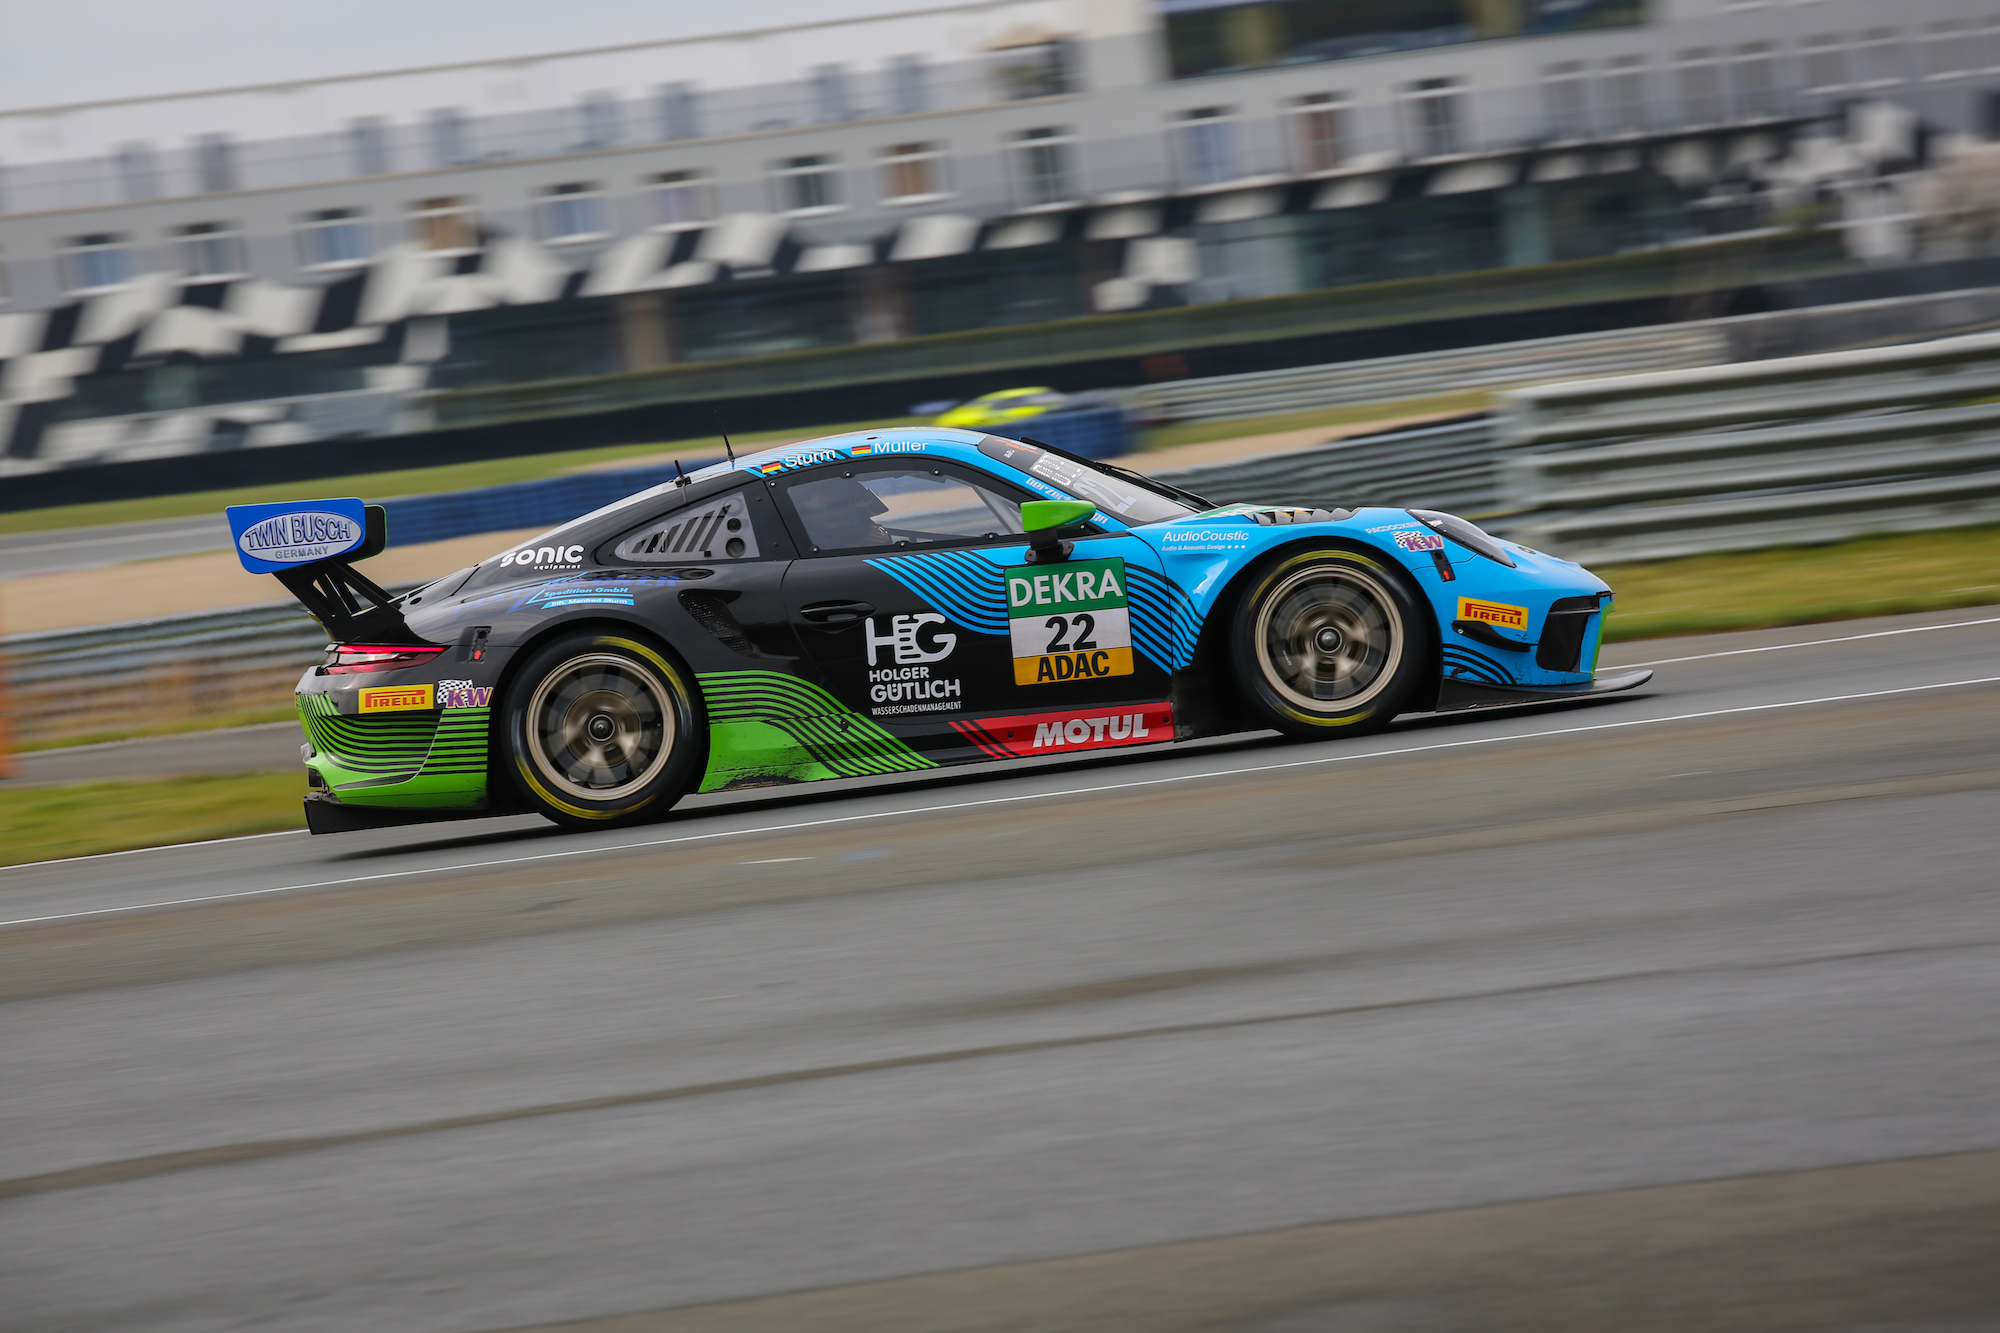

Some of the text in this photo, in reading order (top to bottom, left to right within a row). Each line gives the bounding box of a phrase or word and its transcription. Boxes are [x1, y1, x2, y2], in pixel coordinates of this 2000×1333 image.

[874, 441, 929, 454] Müller
[784, 449, 836, 468] Sturm
[245, 514, 351, 548] TWIN BUSCH
[1162, 530, 1249, 542] AudioCoustic
[275, 546, 328, 559] GERMANY
[1404, 535, 1445, 552] KW
[544, 588, 592, 597] Spedition
[1009, 568, 1123, 607] DEKRA
[1464, 602, 1522, 625] PIRELLI
[1045, 613, 1097, 653] 22
[869, 666, 930, 682] HOLGER
[1037, 651, 1110, 682] ADAC
[365, 689, 426, 708] PIRELLI
[445, 687, 493, 708] KW
[870, 679, 961, 702] GÜTLICH
[871, 701, 961, 716] WASSERSCHADENMANAGEMENT
[1032, 713, 1150, 748] MOTUL
